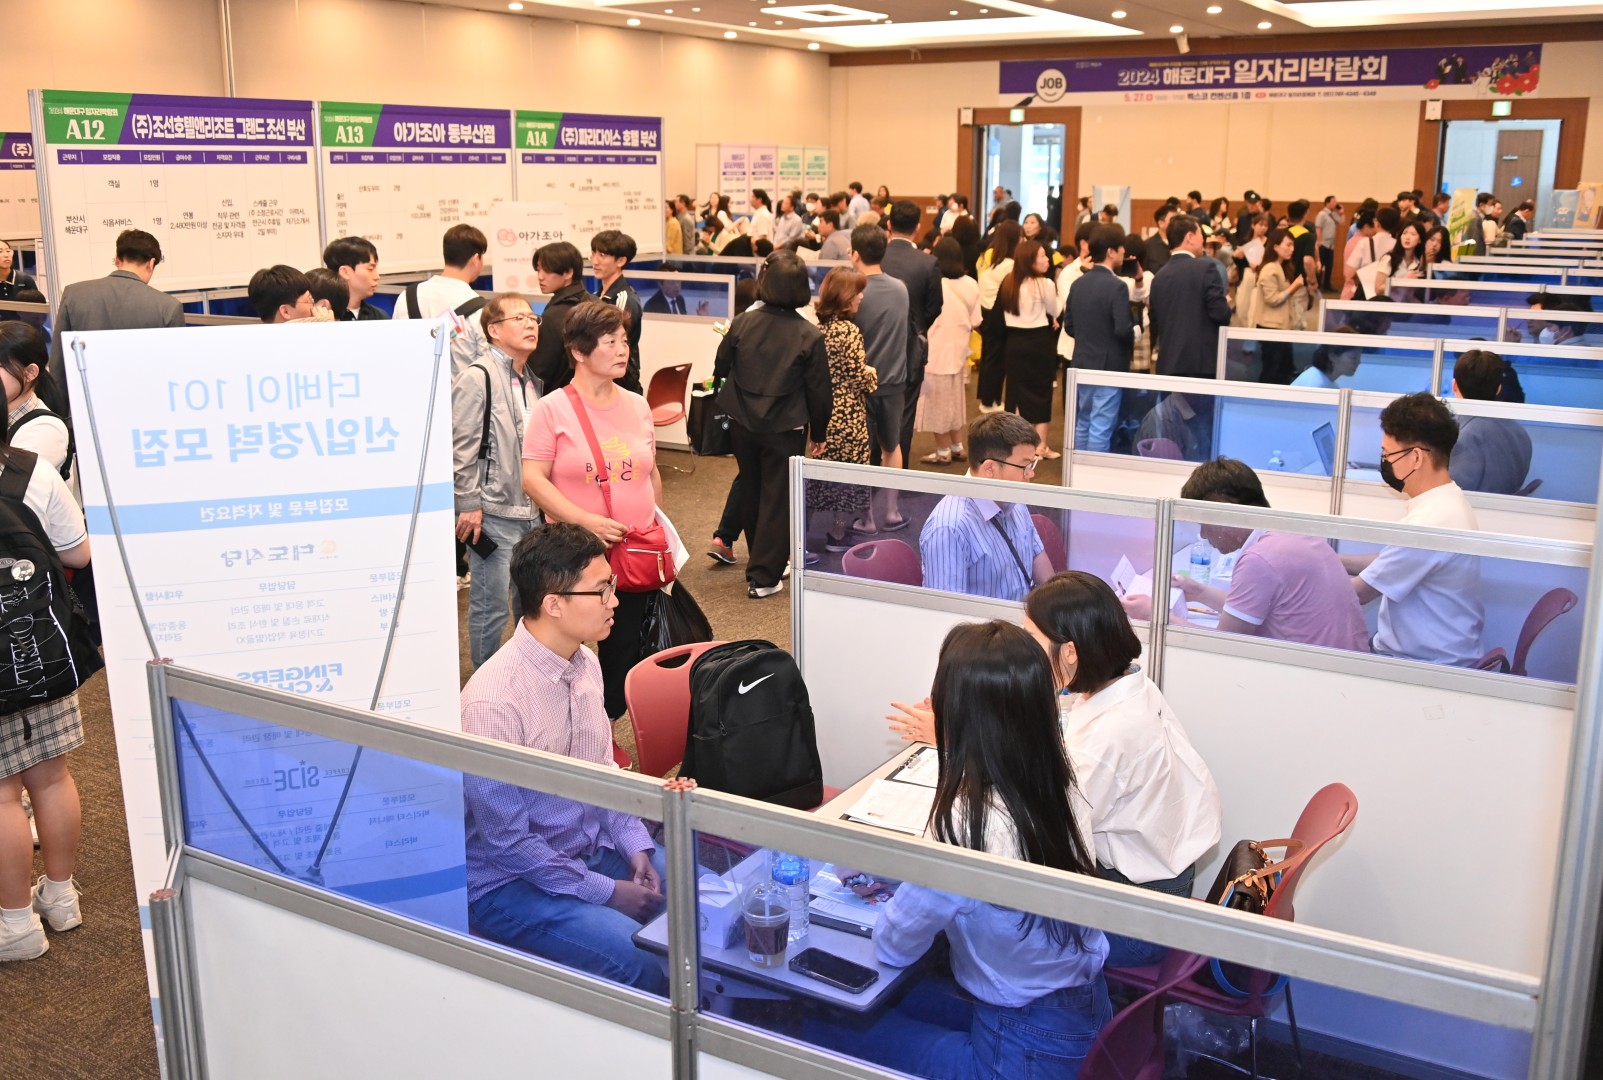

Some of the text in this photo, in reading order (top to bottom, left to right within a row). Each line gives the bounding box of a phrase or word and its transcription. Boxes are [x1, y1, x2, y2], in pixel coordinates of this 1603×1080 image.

[1163, 66, 1231, 85] 해운대구
[1234, 56, 1388, 83] 일자리박람회
[1040, 78, 1063, 89] JOB
[66, 119, 106, 140] A12
[236, 118, 266, 140] 그랜드
[266, 118, 286, 140] 조선
[287, 119, 306, 141] 부산
[336, 126, 364, 143] A13
[394, 122, 496, 144] 아가조아 동부산점
[526, 131, 548, 147] A14
[622, 130, 640, 147] 호텔
[640, 130, 657, 147] 부산
[108, 180, 121, 188] 객실
[150, 179, 159, 187] 1명
[66, 215, 86, 224] 부산시
[182, 211, 194, 219] 연봉
[102, 218, 133, 227] 식음서비스
[152, 217, 162, 226] 1명
[197, 221, 208, 229] 이상
[65, 226, 89, 234] 해운대구
[518, 231, 564, 241] 아가조아
[586, 459, 641, 473] BNANA
